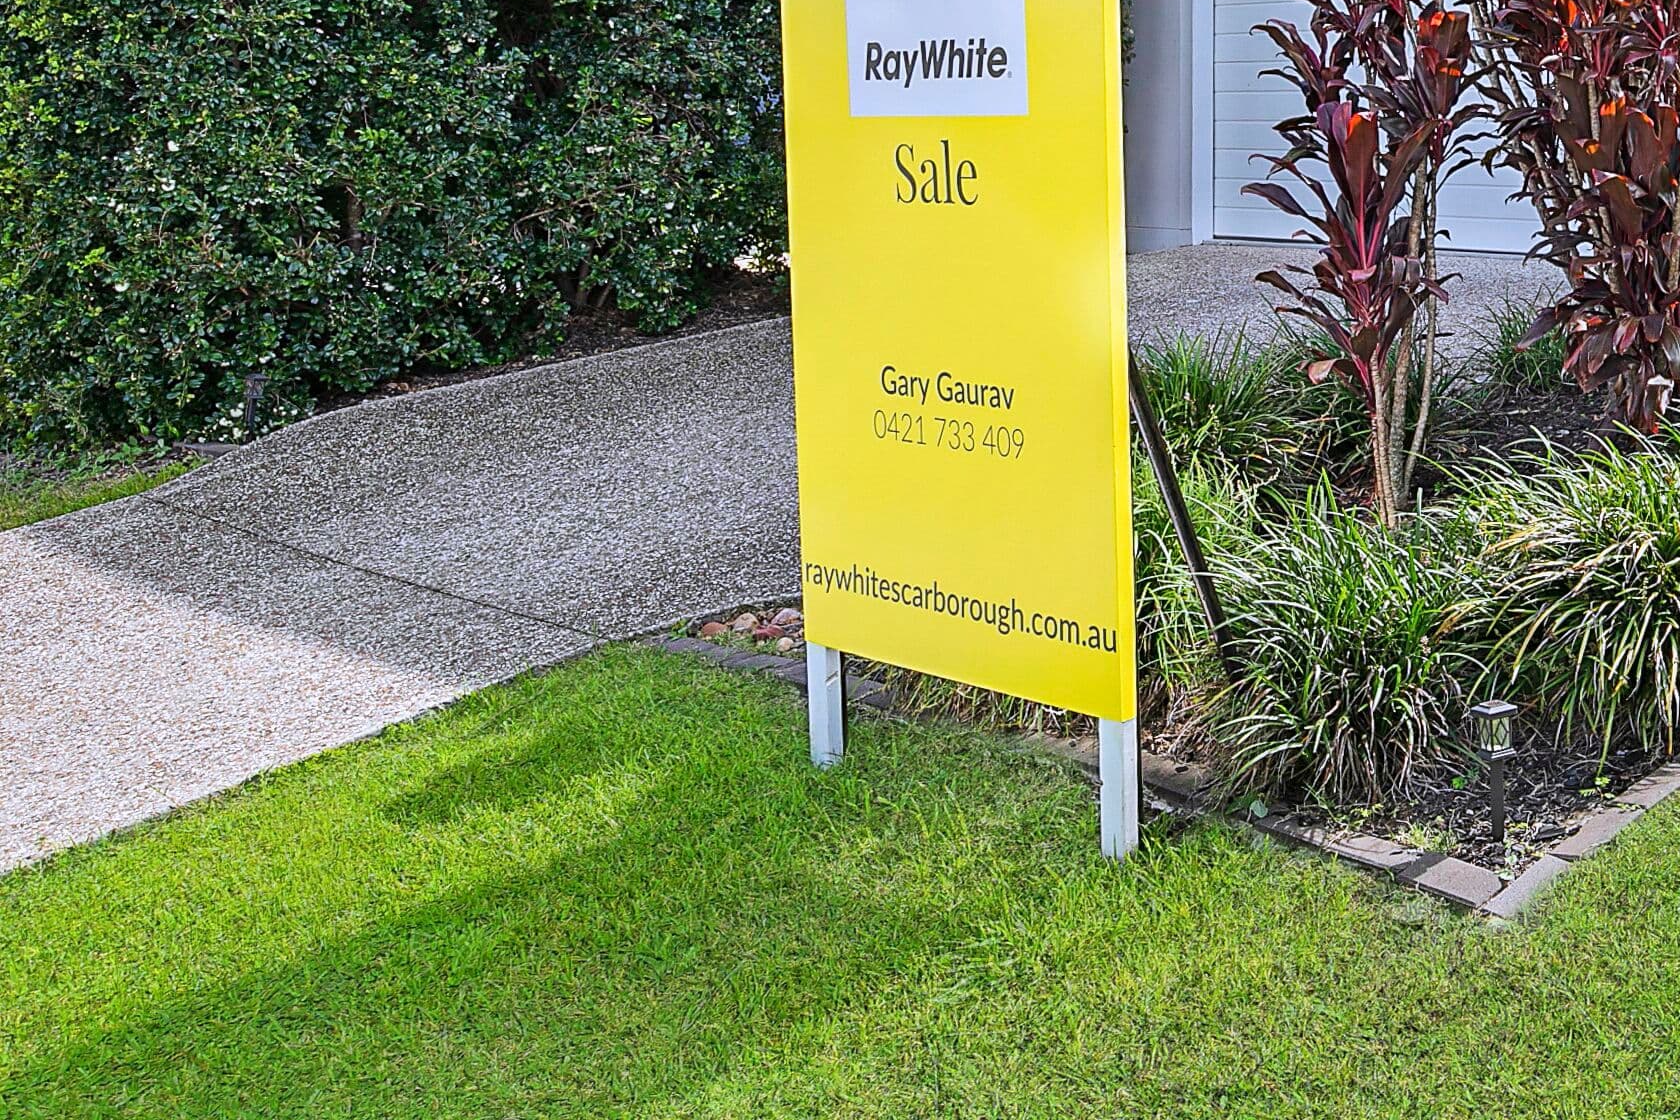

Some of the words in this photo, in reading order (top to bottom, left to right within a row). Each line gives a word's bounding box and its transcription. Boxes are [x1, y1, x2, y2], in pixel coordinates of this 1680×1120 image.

[866, 38, 1008, 88] RayWhite
[896, 139, 978, 205] Sale
[881, 366, 930, 405] Gary
[936, 372, 1014, 409] Gaurav
[874, 410, 926, 445] 0421
[933, 418, 975, 451] 733
[982, 425, 1024, 459] 409
[805, 562, 1117, 653] raywhitescarborough.com.au
